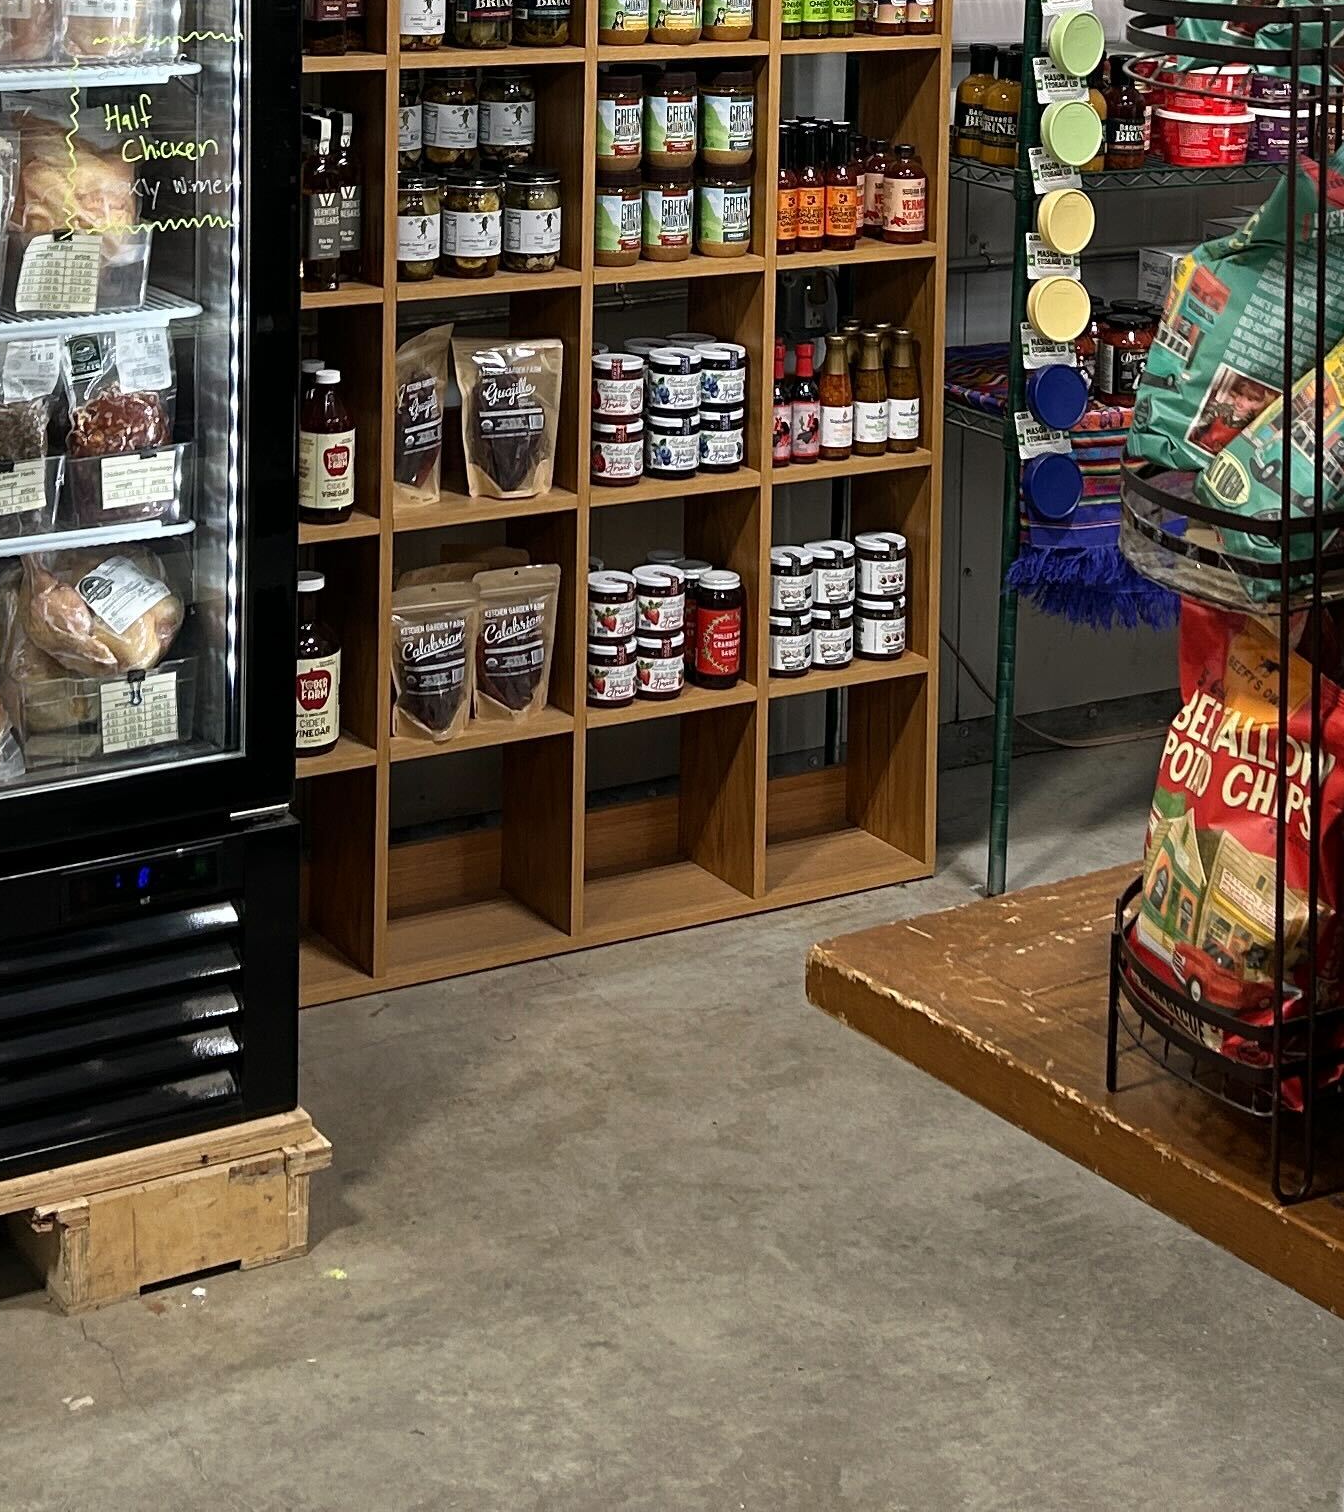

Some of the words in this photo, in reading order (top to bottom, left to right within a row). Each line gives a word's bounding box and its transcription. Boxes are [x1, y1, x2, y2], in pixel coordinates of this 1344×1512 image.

[105, 94, 152, 133] Half
[122, 136, 218, 163] Chicken
[402, 632, 464, 662] Calabrian
